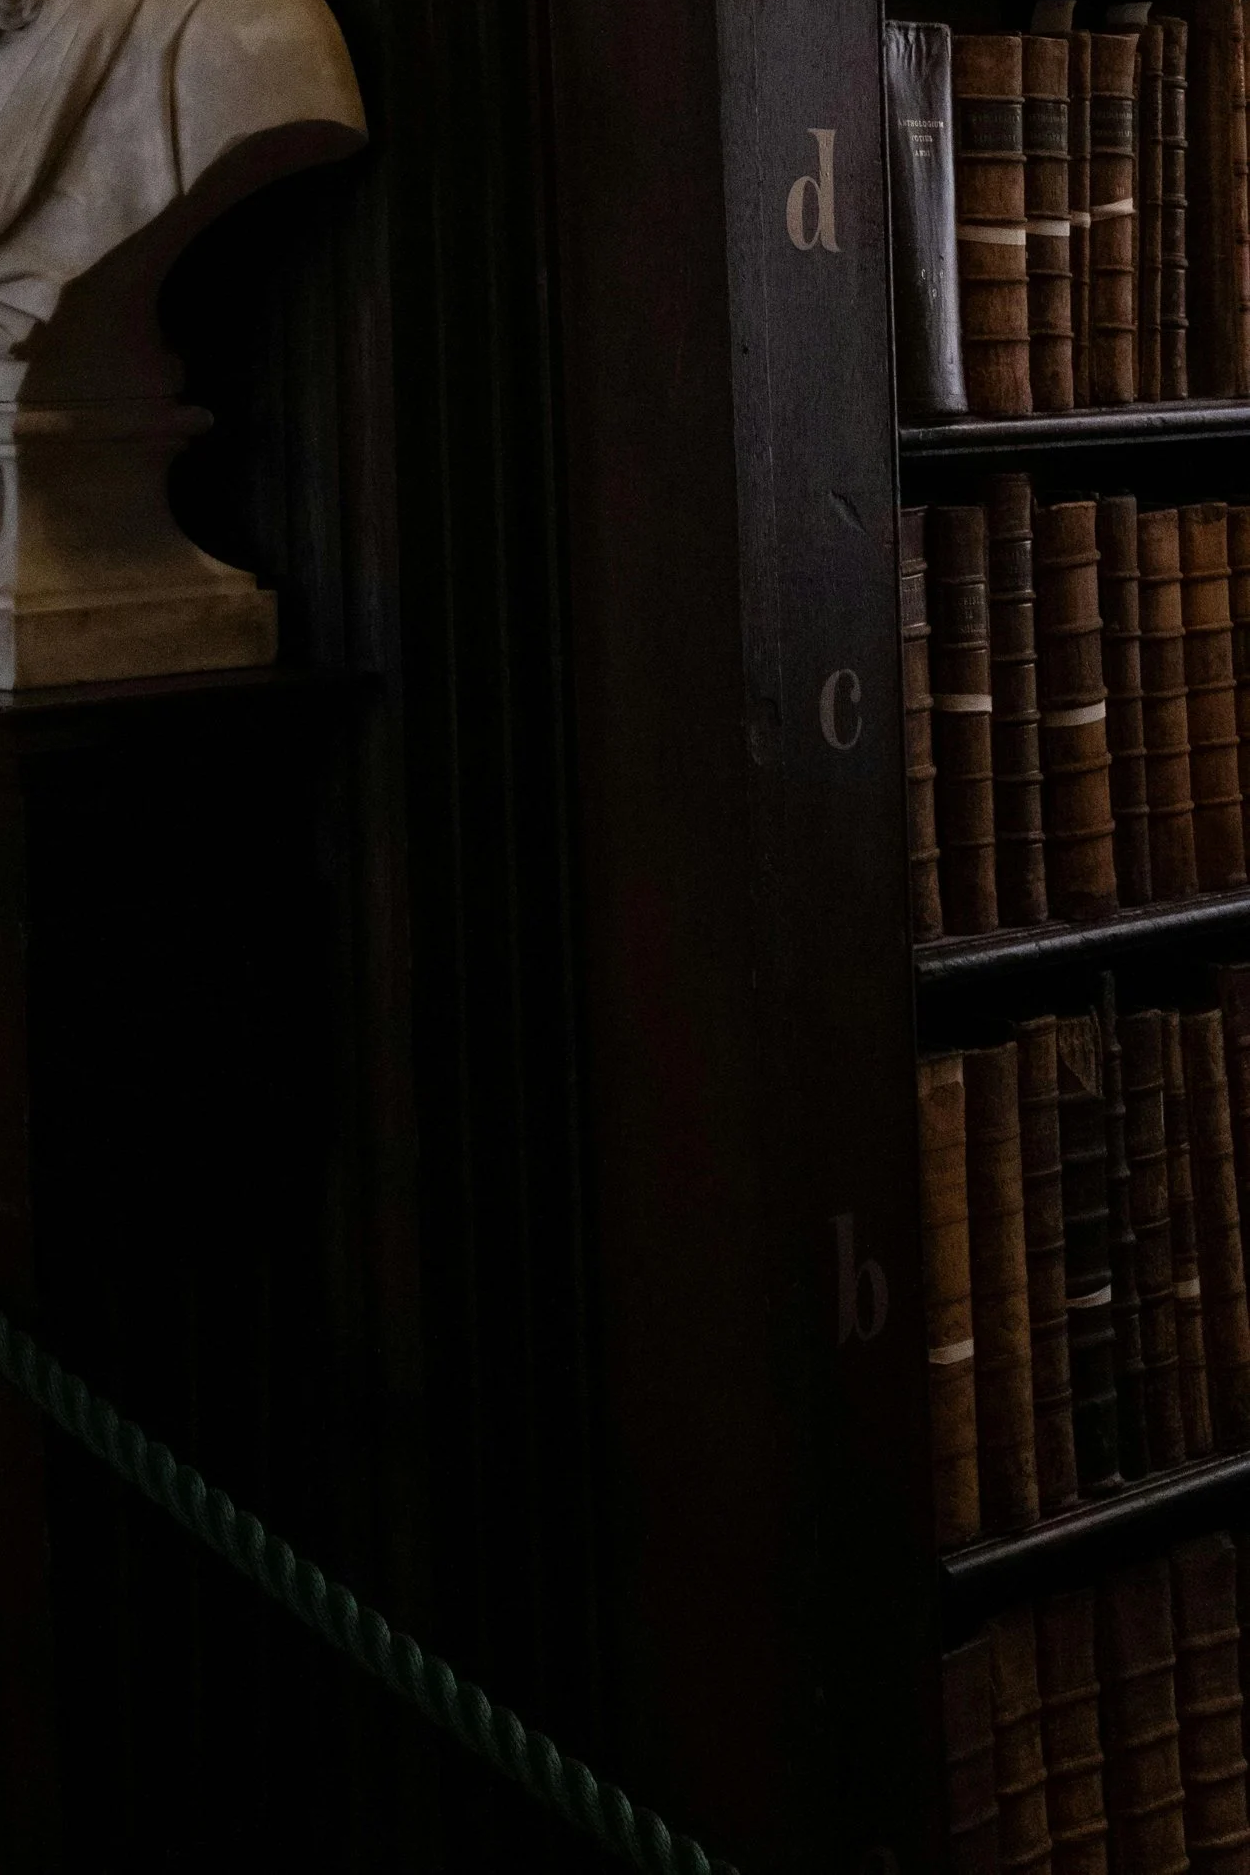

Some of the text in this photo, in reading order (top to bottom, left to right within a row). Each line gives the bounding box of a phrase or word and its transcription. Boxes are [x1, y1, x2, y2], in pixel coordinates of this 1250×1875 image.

[785, 127, 840, 252] d
[819, 668, 863, 751] c
[829, 1210, 889, 1345] b
